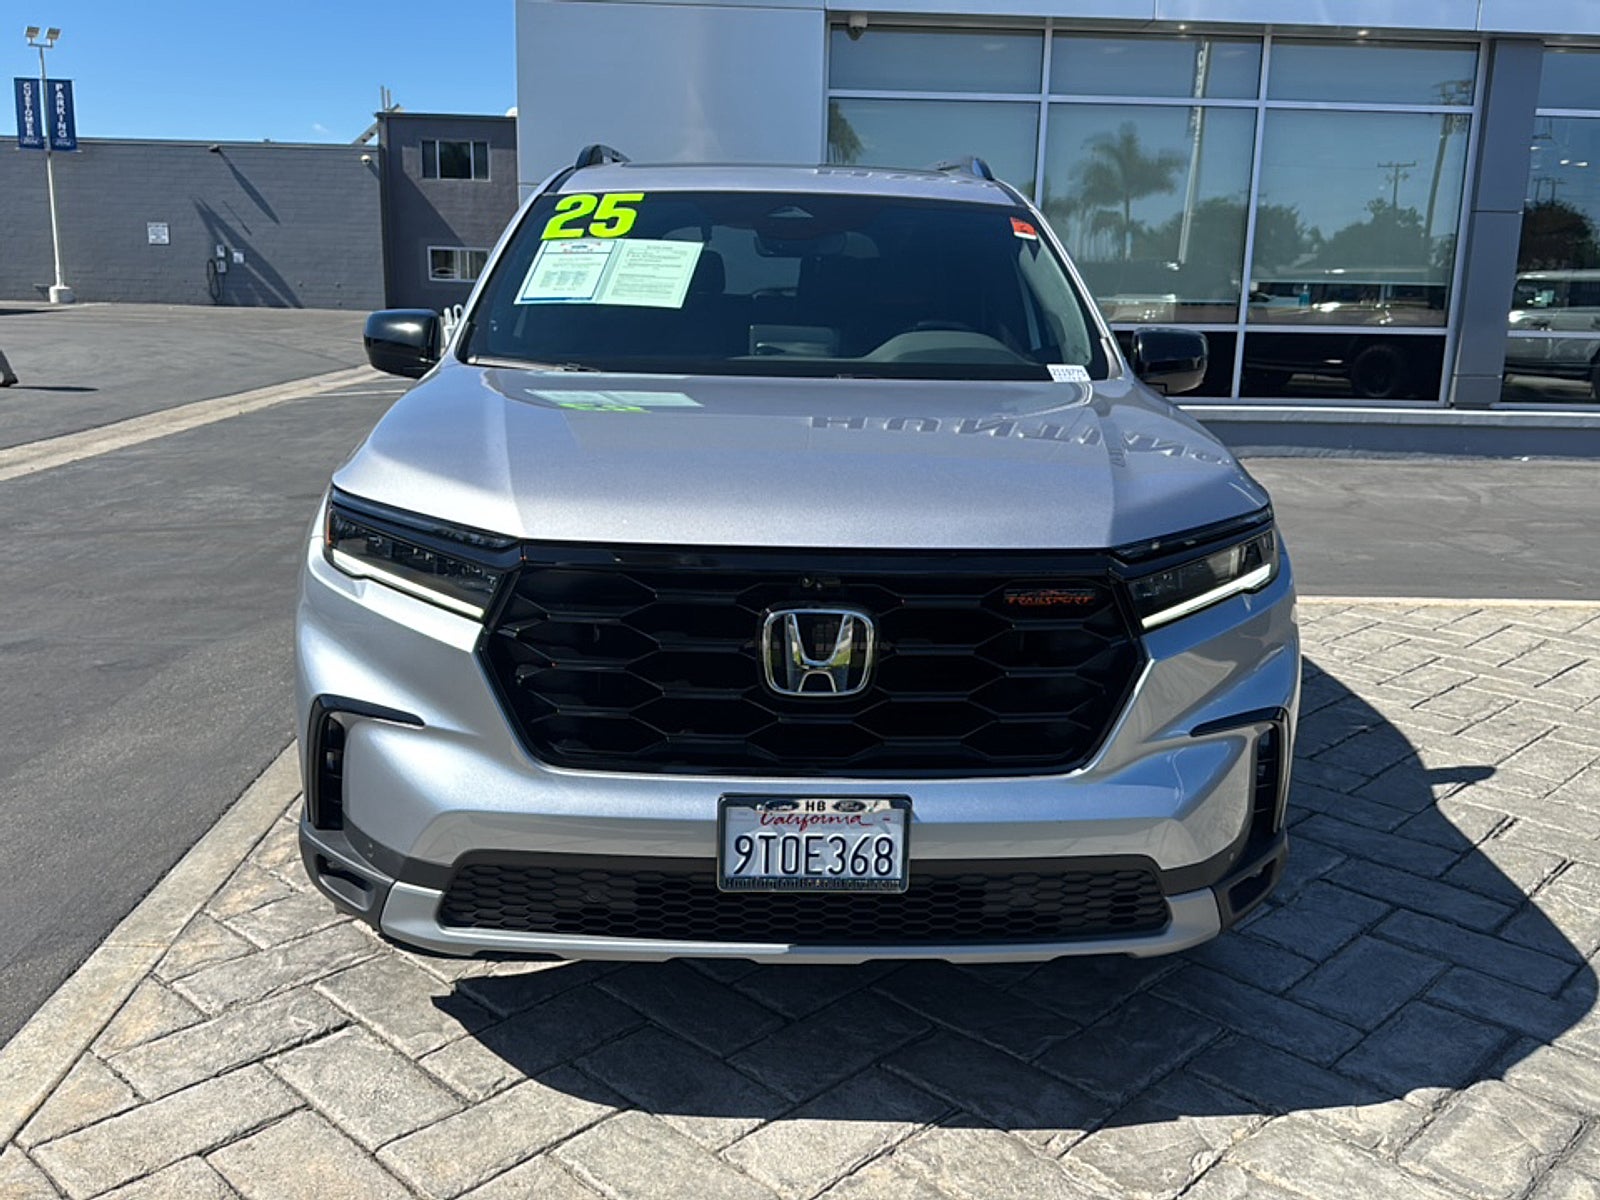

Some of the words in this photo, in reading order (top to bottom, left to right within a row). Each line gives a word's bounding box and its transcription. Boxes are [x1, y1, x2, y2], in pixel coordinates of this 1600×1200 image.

[23, 82, 35, 137] CUSTOMER
[54, 83, 67, 138] PARKING
[541, 192, 644, 240] 25
[760, 812, 874, 832] California
[804, 800, 827, 812] HB
